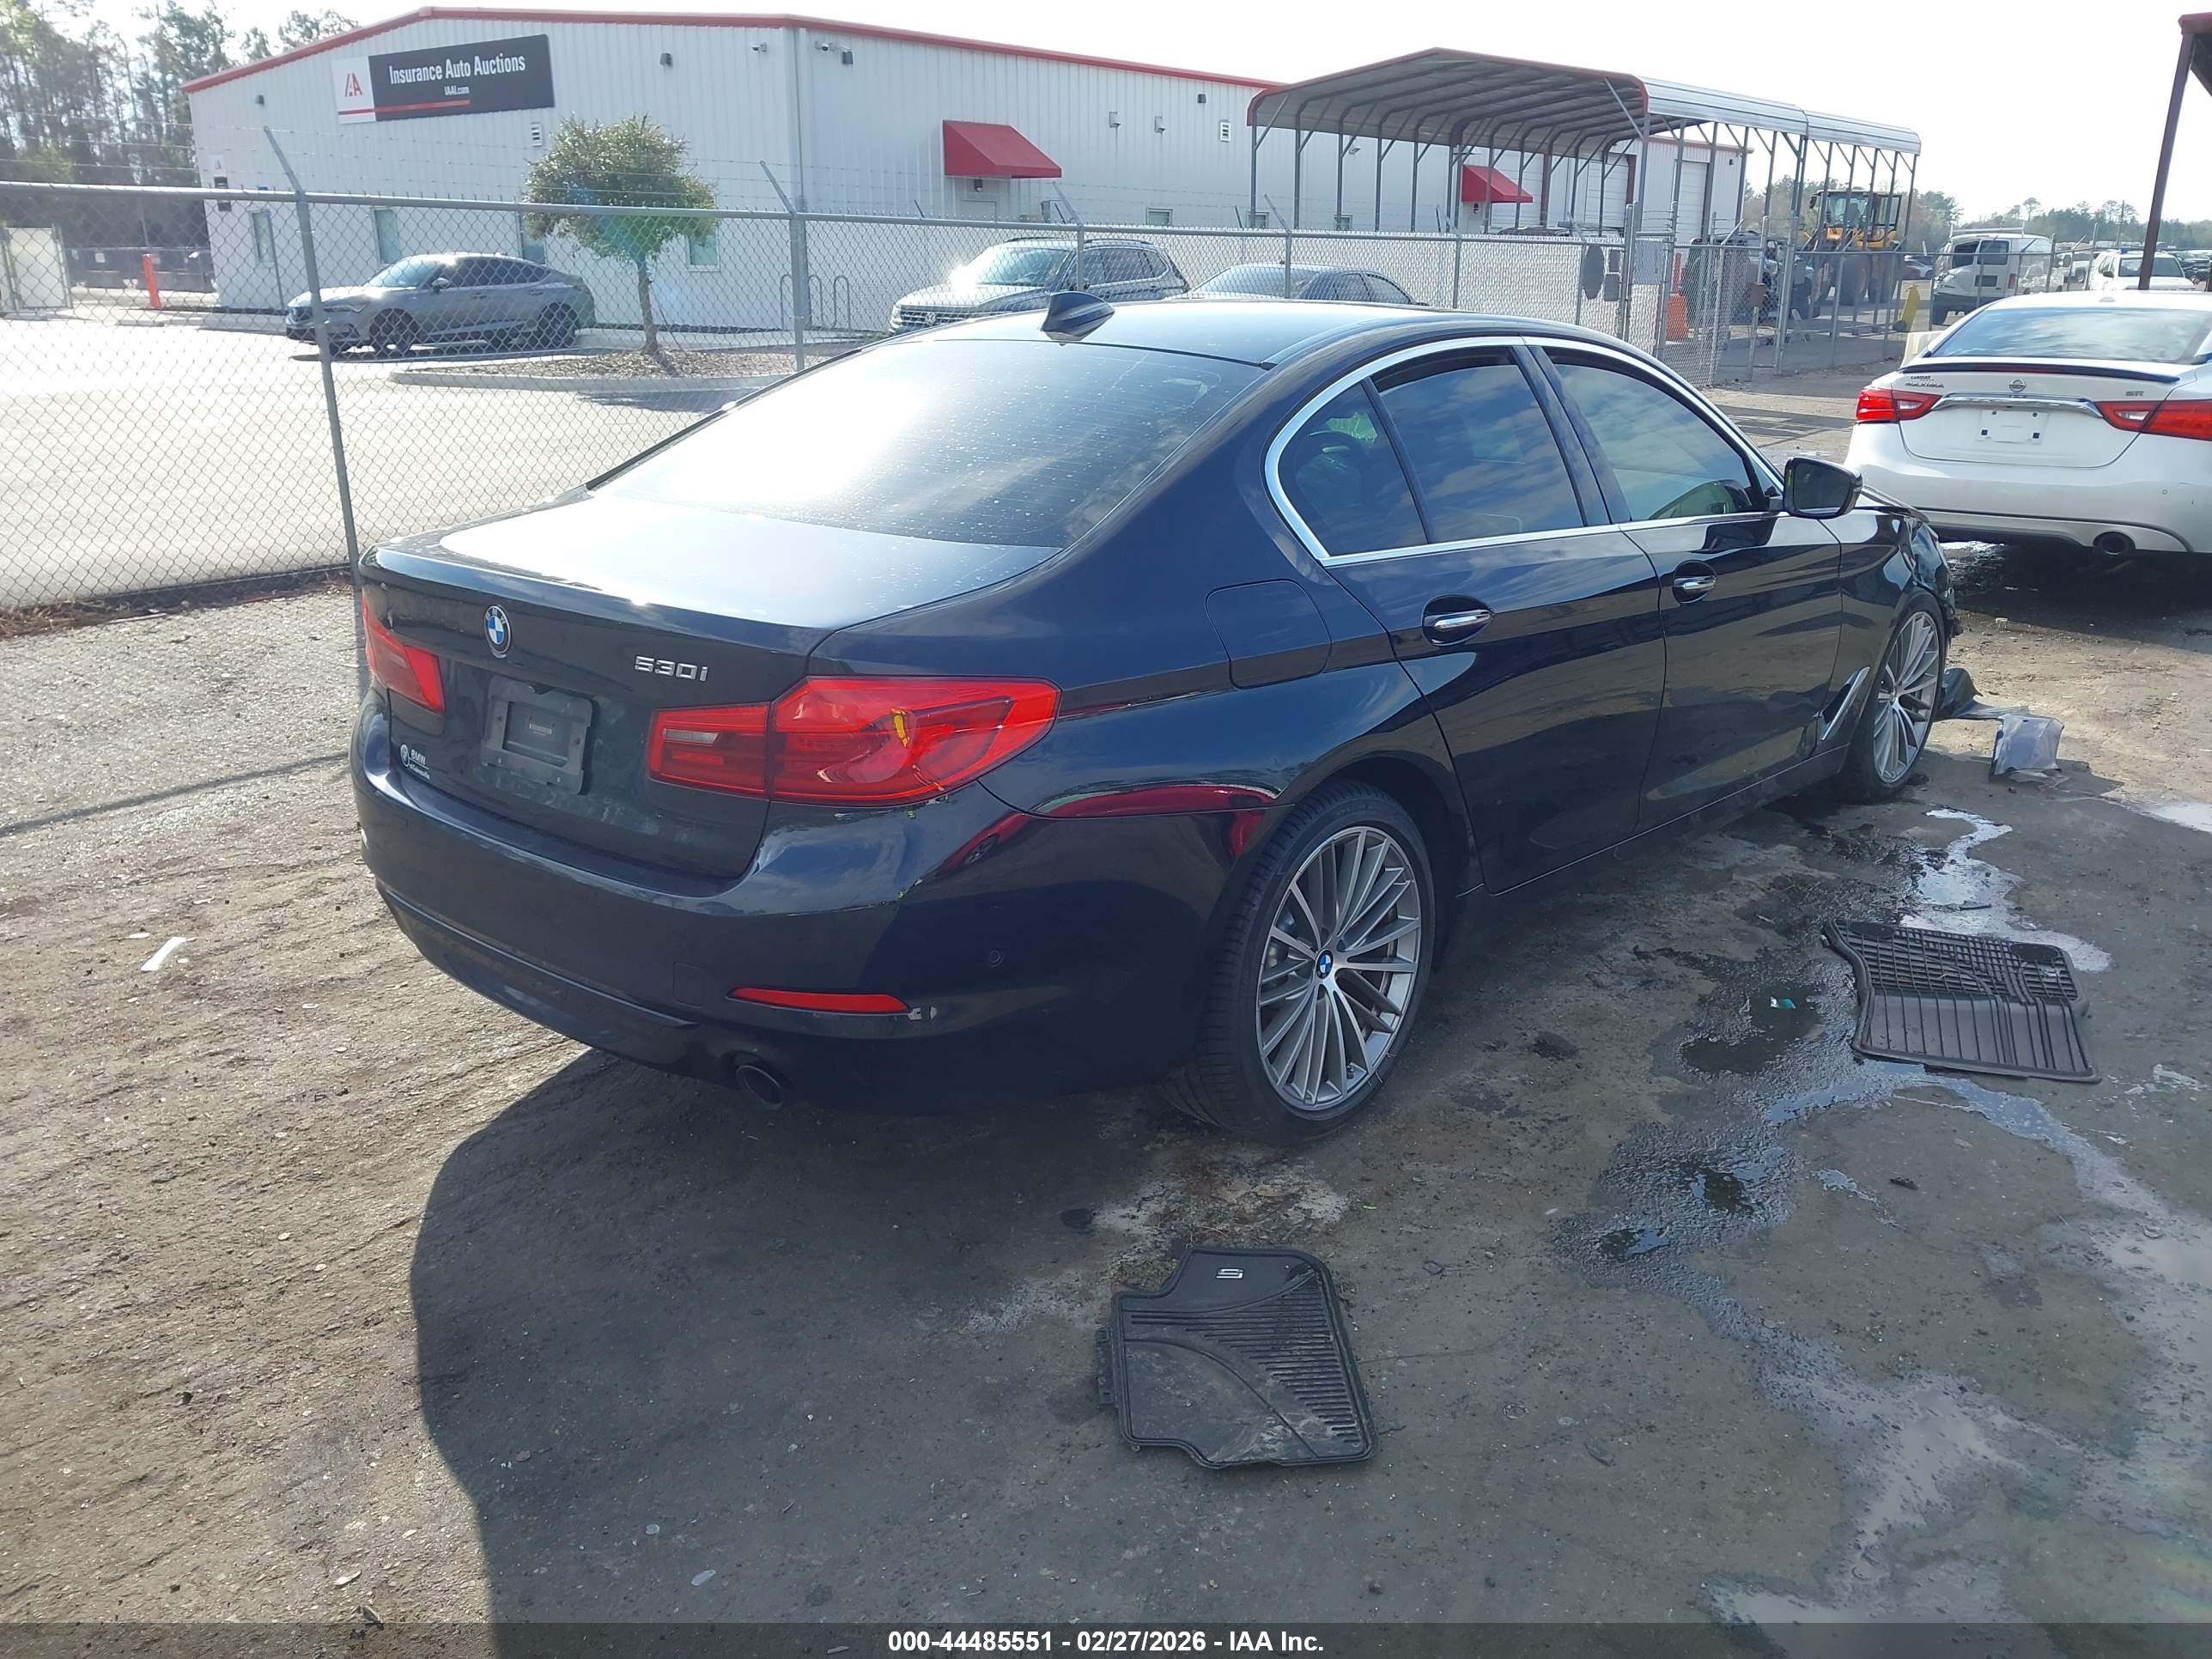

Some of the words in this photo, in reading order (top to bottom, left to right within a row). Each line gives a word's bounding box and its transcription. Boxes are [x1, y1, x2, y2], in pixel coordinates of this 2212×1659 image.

[389, 65, 442, 84] Insurance
[445, 58, 471, 79] Auto
[474, 52, 526, 76] Auctions
[635, 655, 708, 681] 530i
